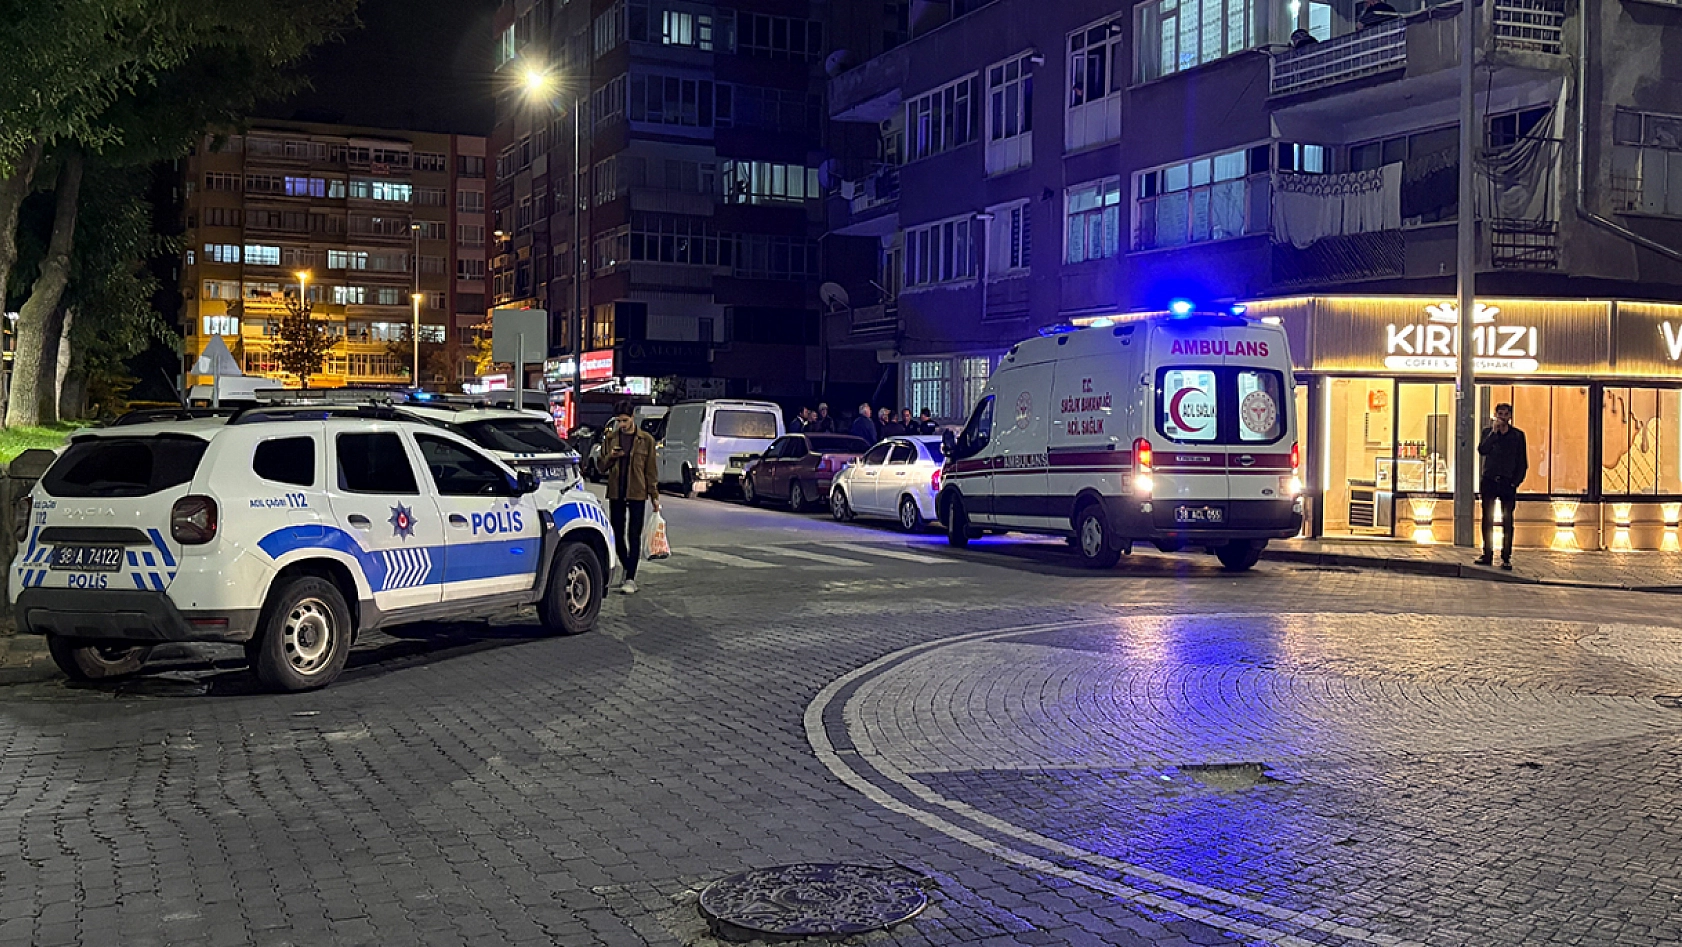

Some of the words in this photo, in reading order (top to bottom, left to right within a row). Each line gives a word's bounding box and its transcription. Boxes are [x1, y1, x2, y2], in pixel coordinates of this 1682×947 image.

[1171, 339, 1269, 357] AMBULANS
[1386, 323, 1538, 356] KIRMIZI
[1061, 395, 1080, 413] SAĞLIK
[1082, 416, 1104, 435] SAĞLIK
[1004, 453, 1048, 468] AMBULANS
[285, 493, 308, 508] 112
[471, 503, 523, 535] POLİS
[59, 548, 73, 564] 38
[75, 548, 83, 564] A
[88, 548, 120, 564] 74122
[68, 572, 108, 589] POLİS
